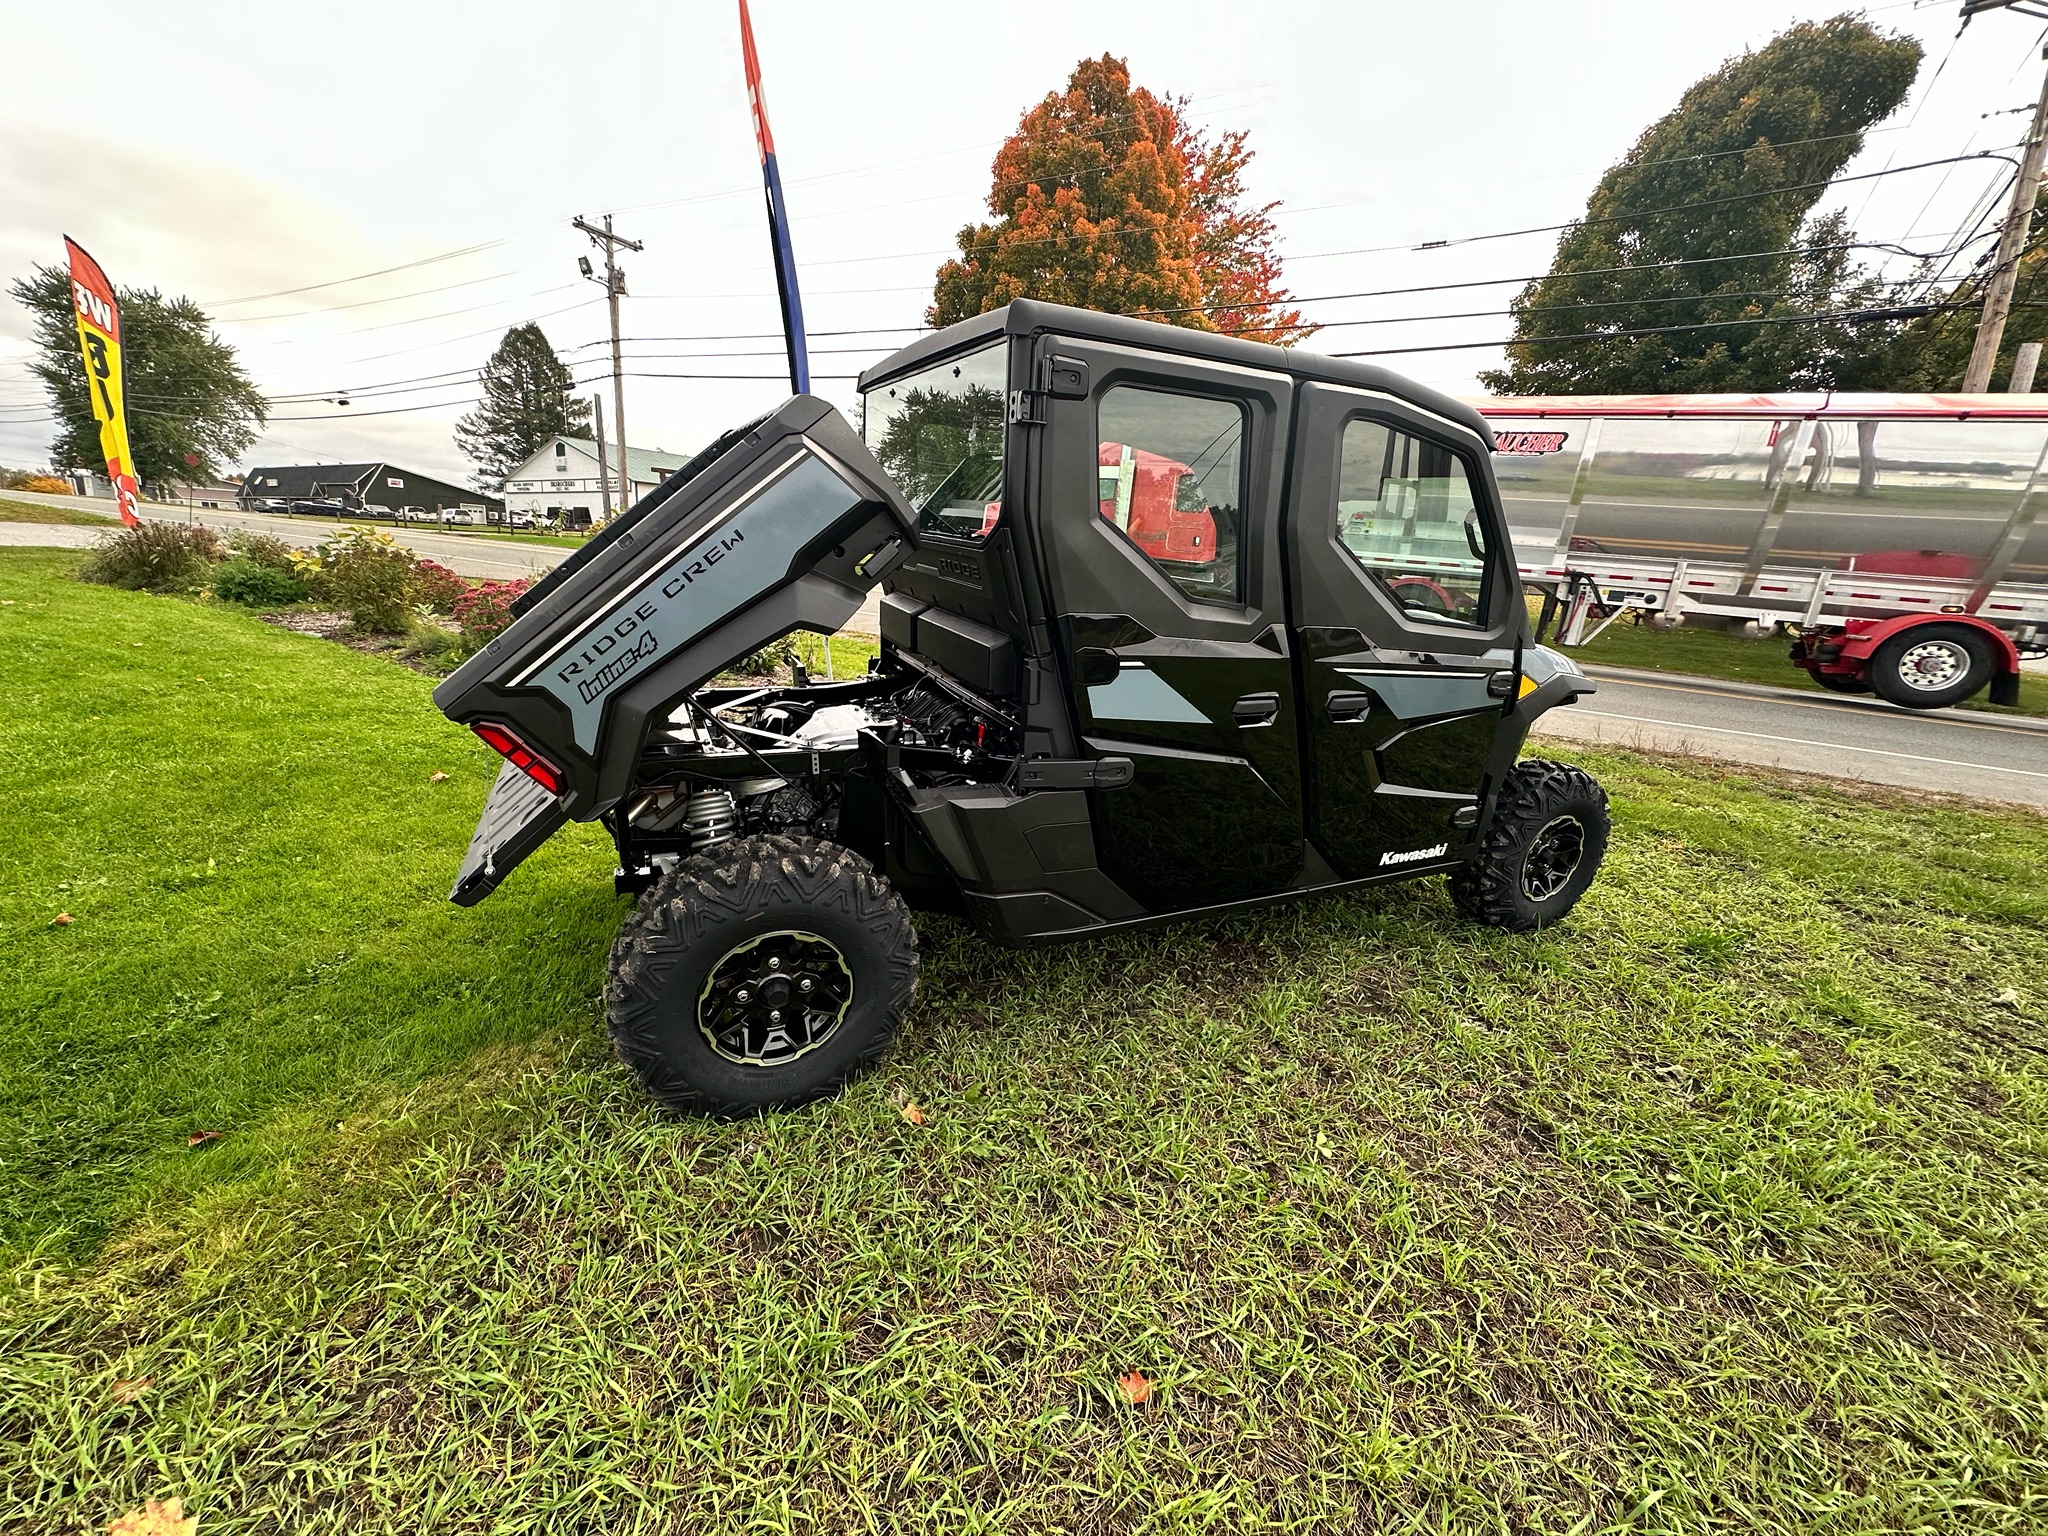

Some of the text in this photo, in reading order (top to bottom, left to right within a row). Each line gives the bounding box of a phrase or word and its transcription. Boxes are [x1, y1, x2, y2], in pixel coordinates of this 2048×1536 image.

[1493, 431, 1566, 452] AUCHER
[938, 557, 982, 578] RIDGE
[557, 529, 745, 684] RIDGE CREW
[577, 629, 659, 705] Inline-4
[1379, 843, 1448, 866] Kawasaki
